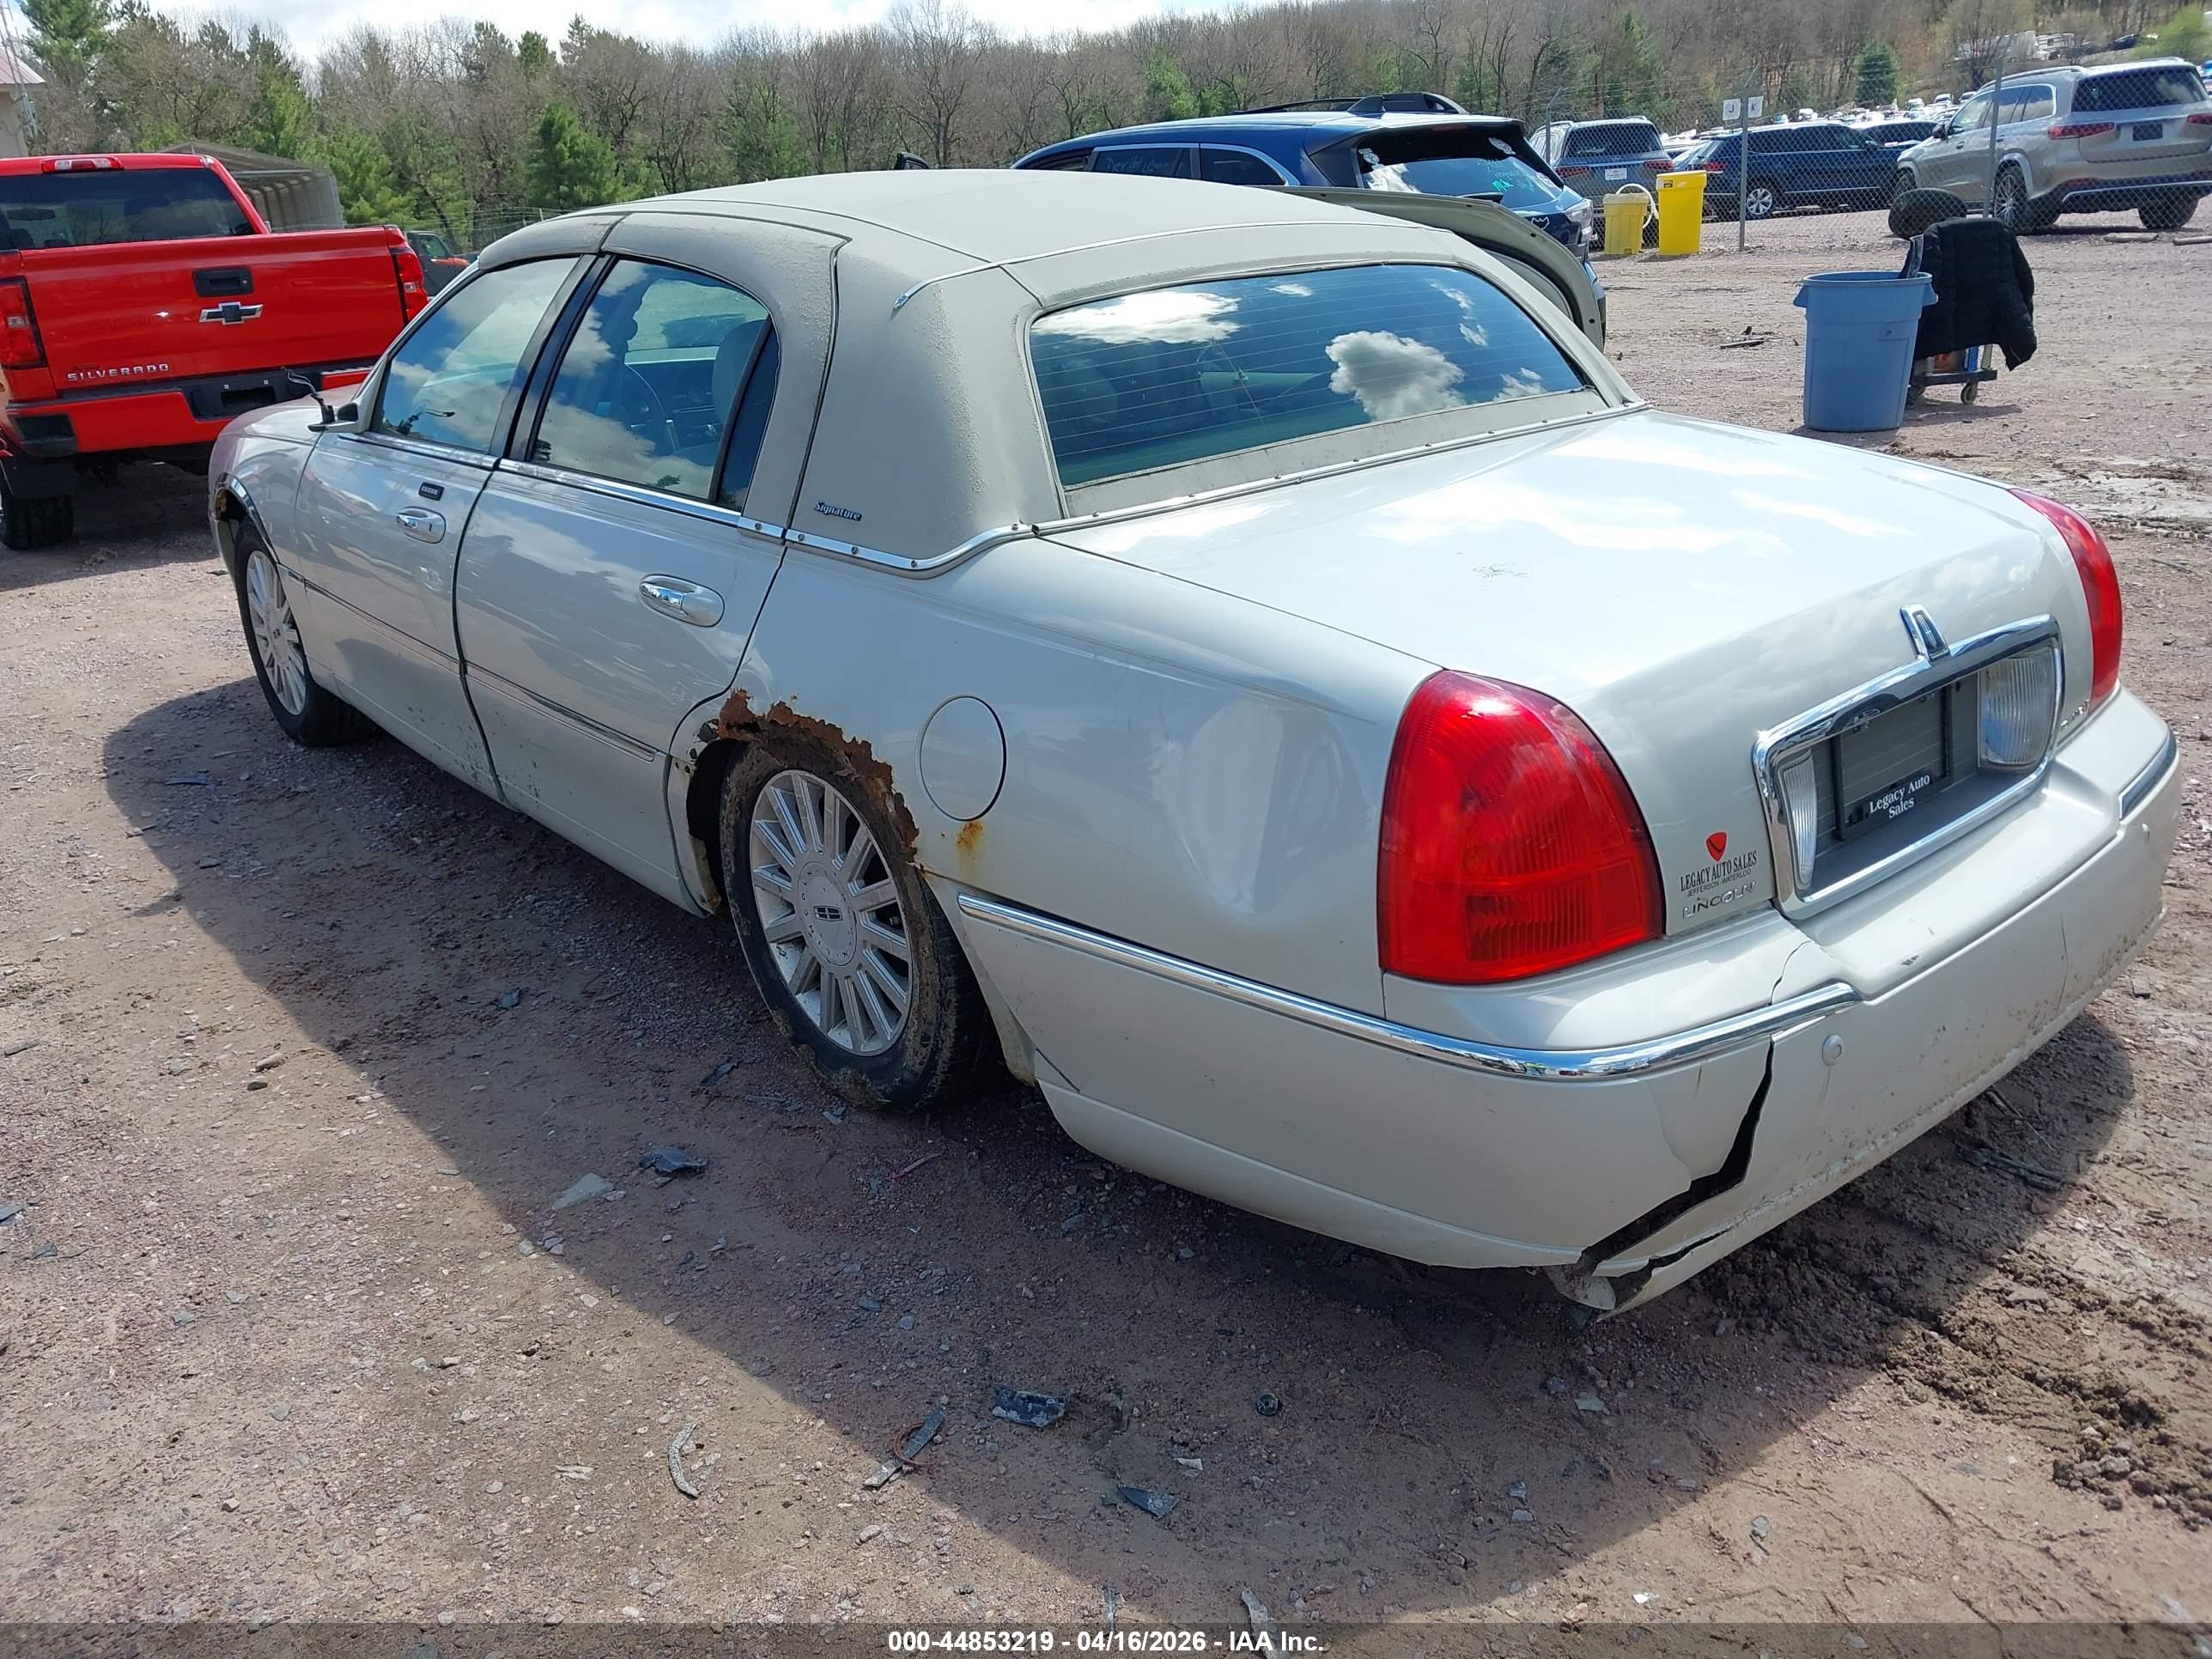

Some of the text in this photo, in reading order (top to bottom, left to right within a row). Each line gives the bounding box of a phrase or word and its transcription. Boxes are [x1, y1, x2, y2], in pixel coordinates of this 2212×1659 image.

[1728, 104, 1735, 113] J
[67, 363, 169, 381] SILVERADO
[813, 501, 862, 521] Signature
[1869, 775, 1930, 813] Legacy Auto
[1888, 797, 1915, 818] Sales
[1680, 850, 1758, 892] LEGACY AUTO SALES
[1682, 880, 1756, 918] LINCOLN
